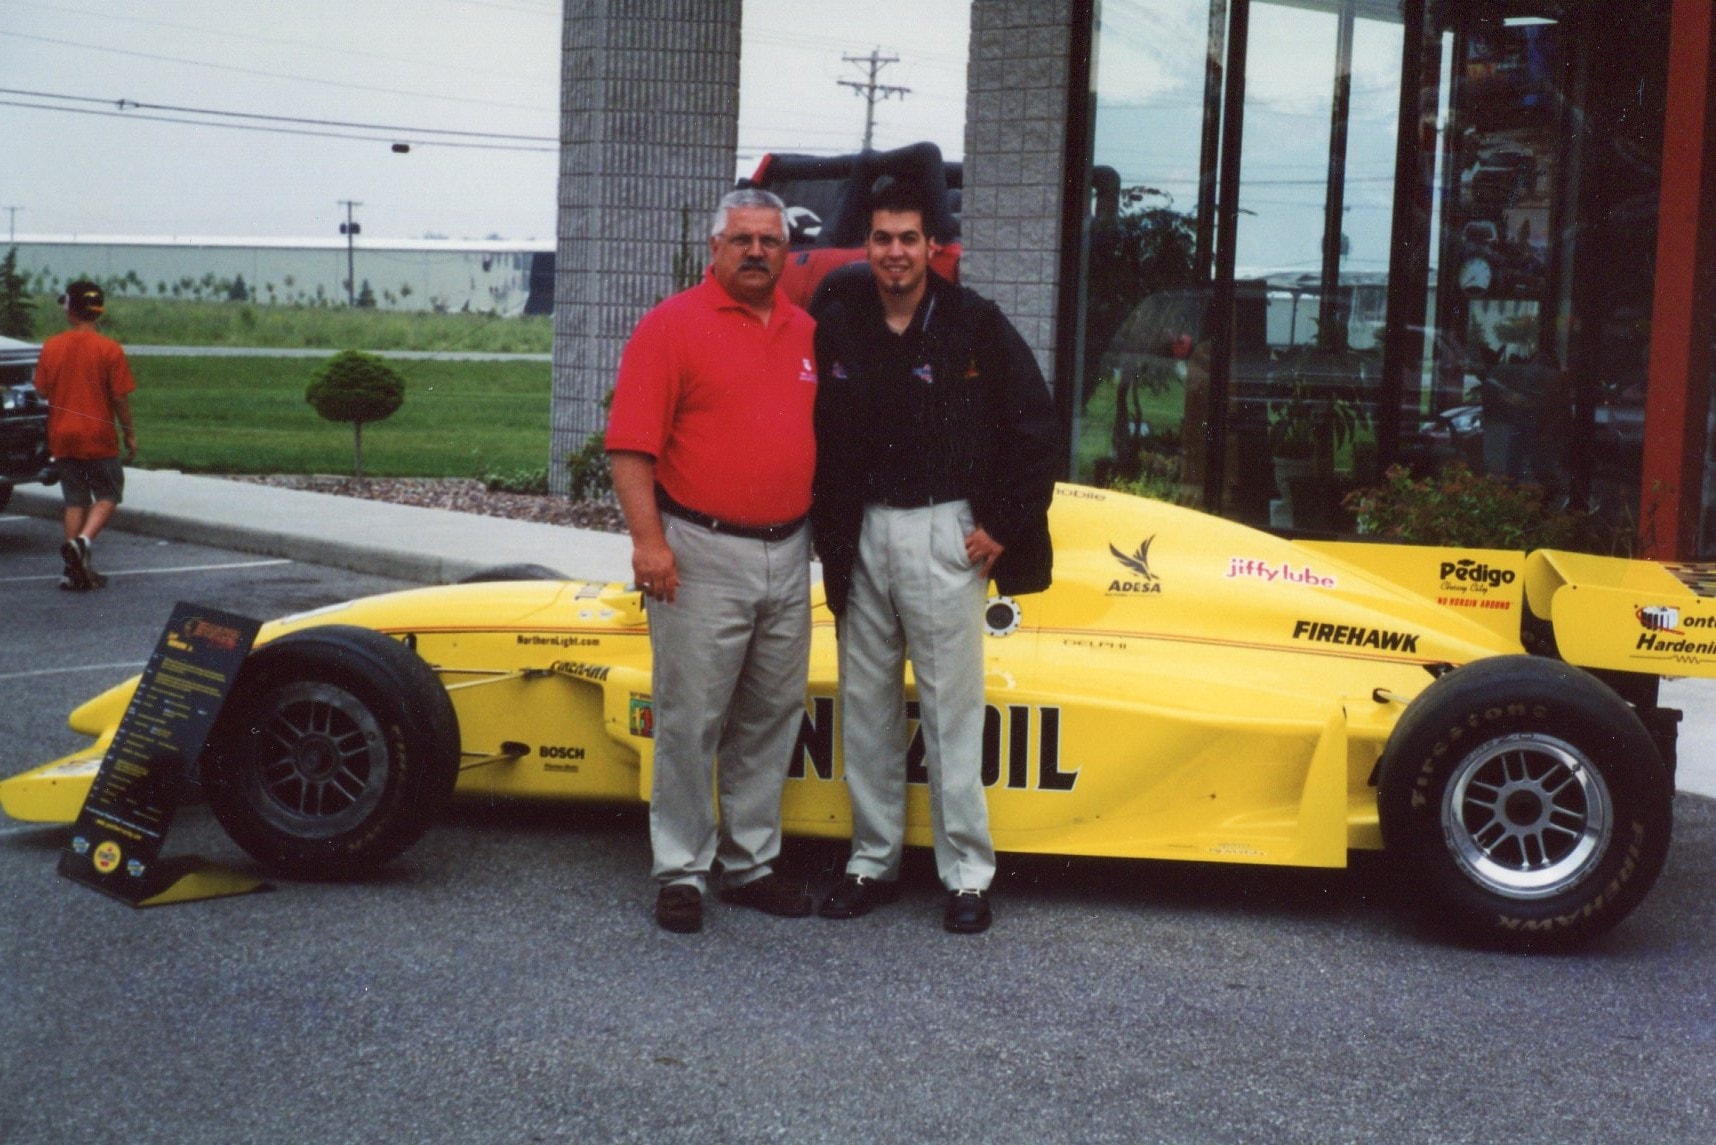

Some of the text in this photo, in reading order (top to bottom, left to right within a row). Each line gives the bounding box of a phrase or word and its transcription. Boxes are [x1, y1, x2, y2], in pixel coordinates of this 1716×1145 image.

[1227, 559, 1334, 588] jiffy lube
[1440, 562, 1515, 587] Pedigo
[1108, 580, 1162, 593] ADESA
[1292, 620, 1420, 653] FIREHAWK
[539, 746, 585, 760] BOSCH
